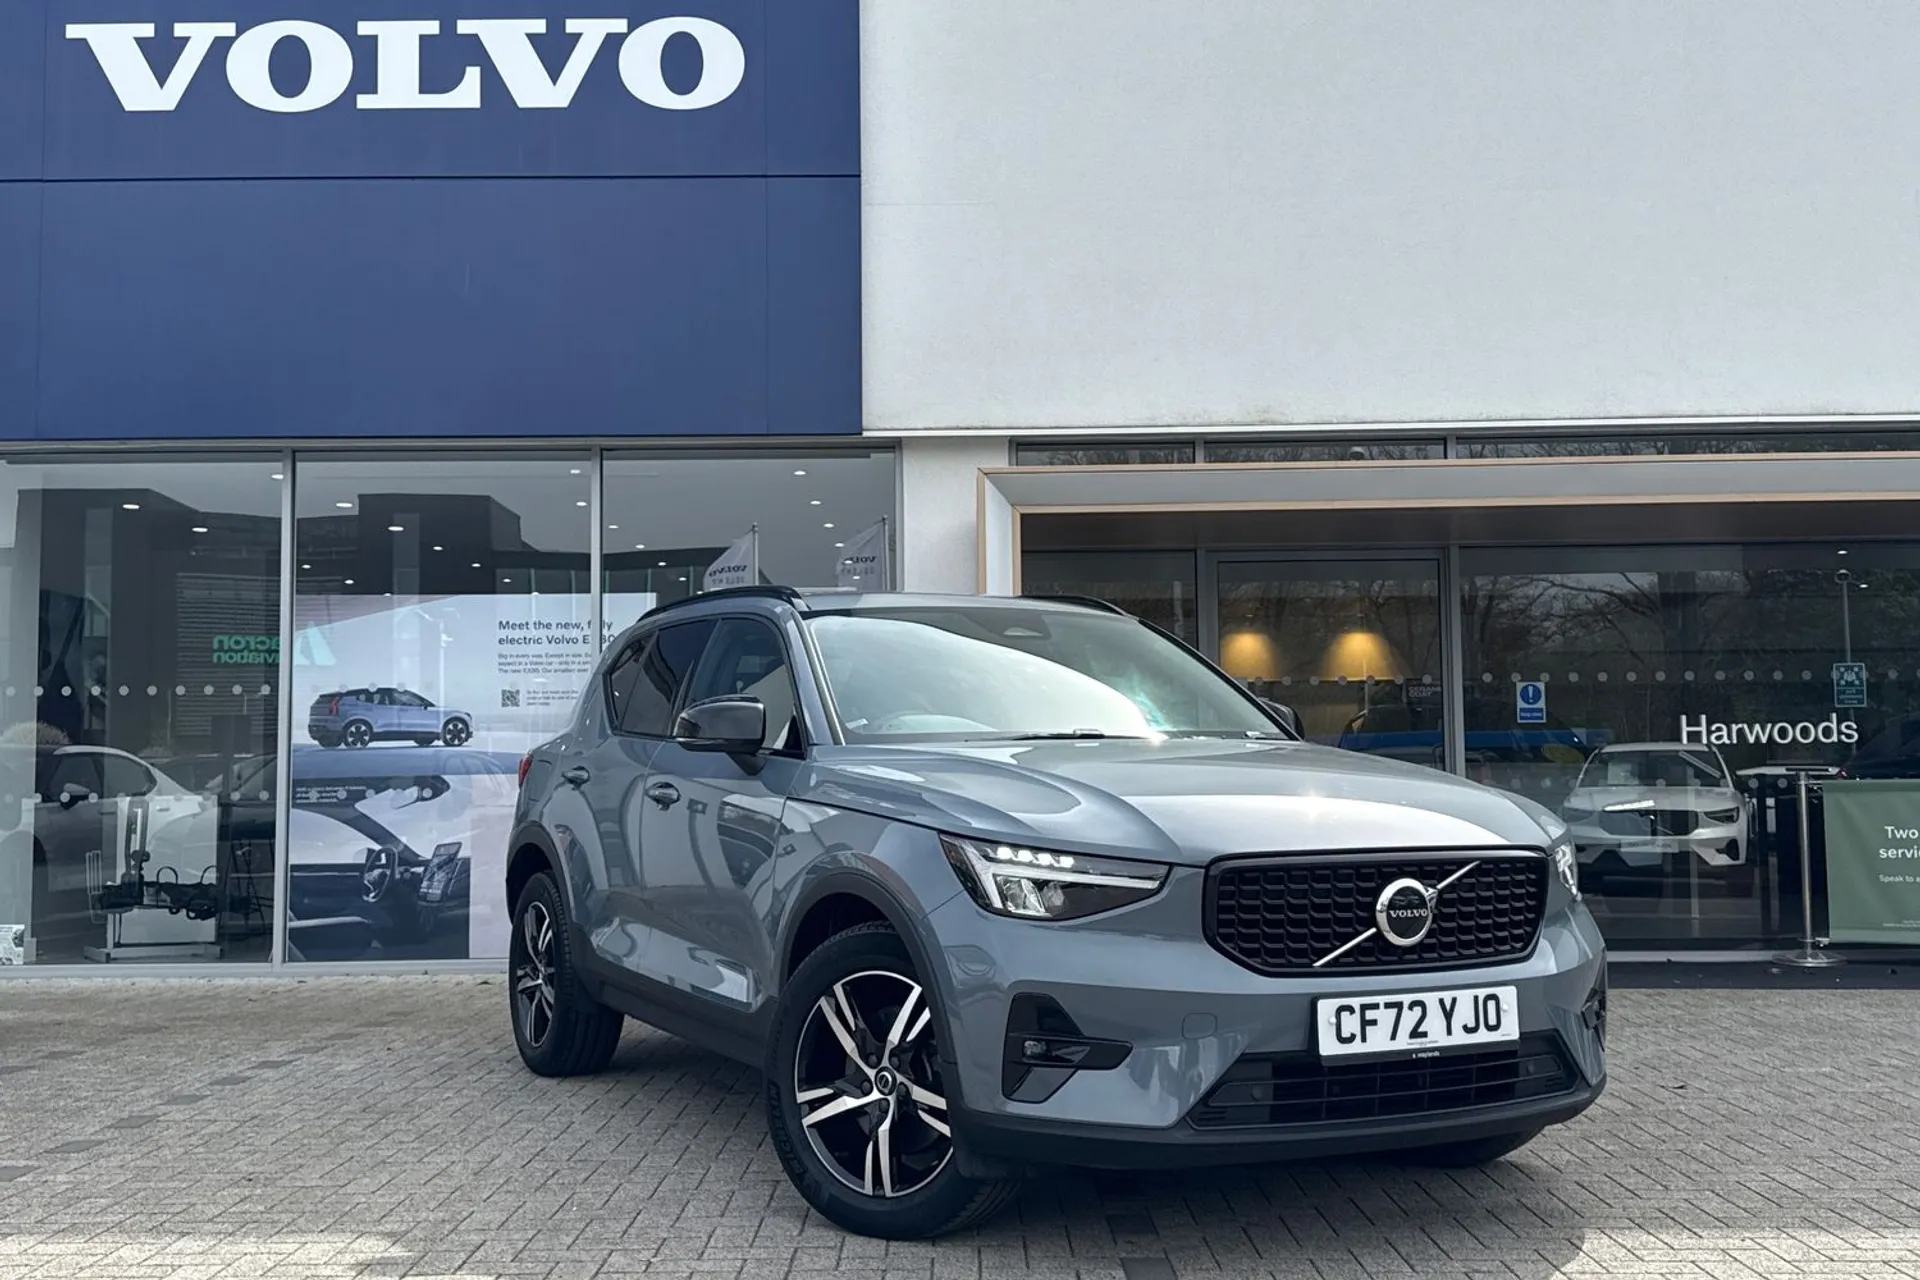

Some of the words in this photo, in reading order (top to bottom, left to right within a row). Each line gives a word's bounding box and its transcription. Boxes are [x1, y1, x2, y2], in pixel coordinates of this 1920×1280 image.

[65, 16, 746, 112] VOLVO
[498, 620, 530, 631] Meet
[533, 620, 552, 630] the
[555, 622, 585, 632] new,
[498, 634, 543, 645] electric
[545, 634, 579, 645] Volvo
[1680, 712, 1859, 745] Harwoods
[1884, 825, 1919, 839] Two
[1879, 845, 1920, 859] servi
[1879, 874, 1904, 883] Speak
[1388, 909, 1428, 918] VOLVO
[1335, 999, 1429, 1045] CF72
[1438, 993, 1501, 1037] YJO
